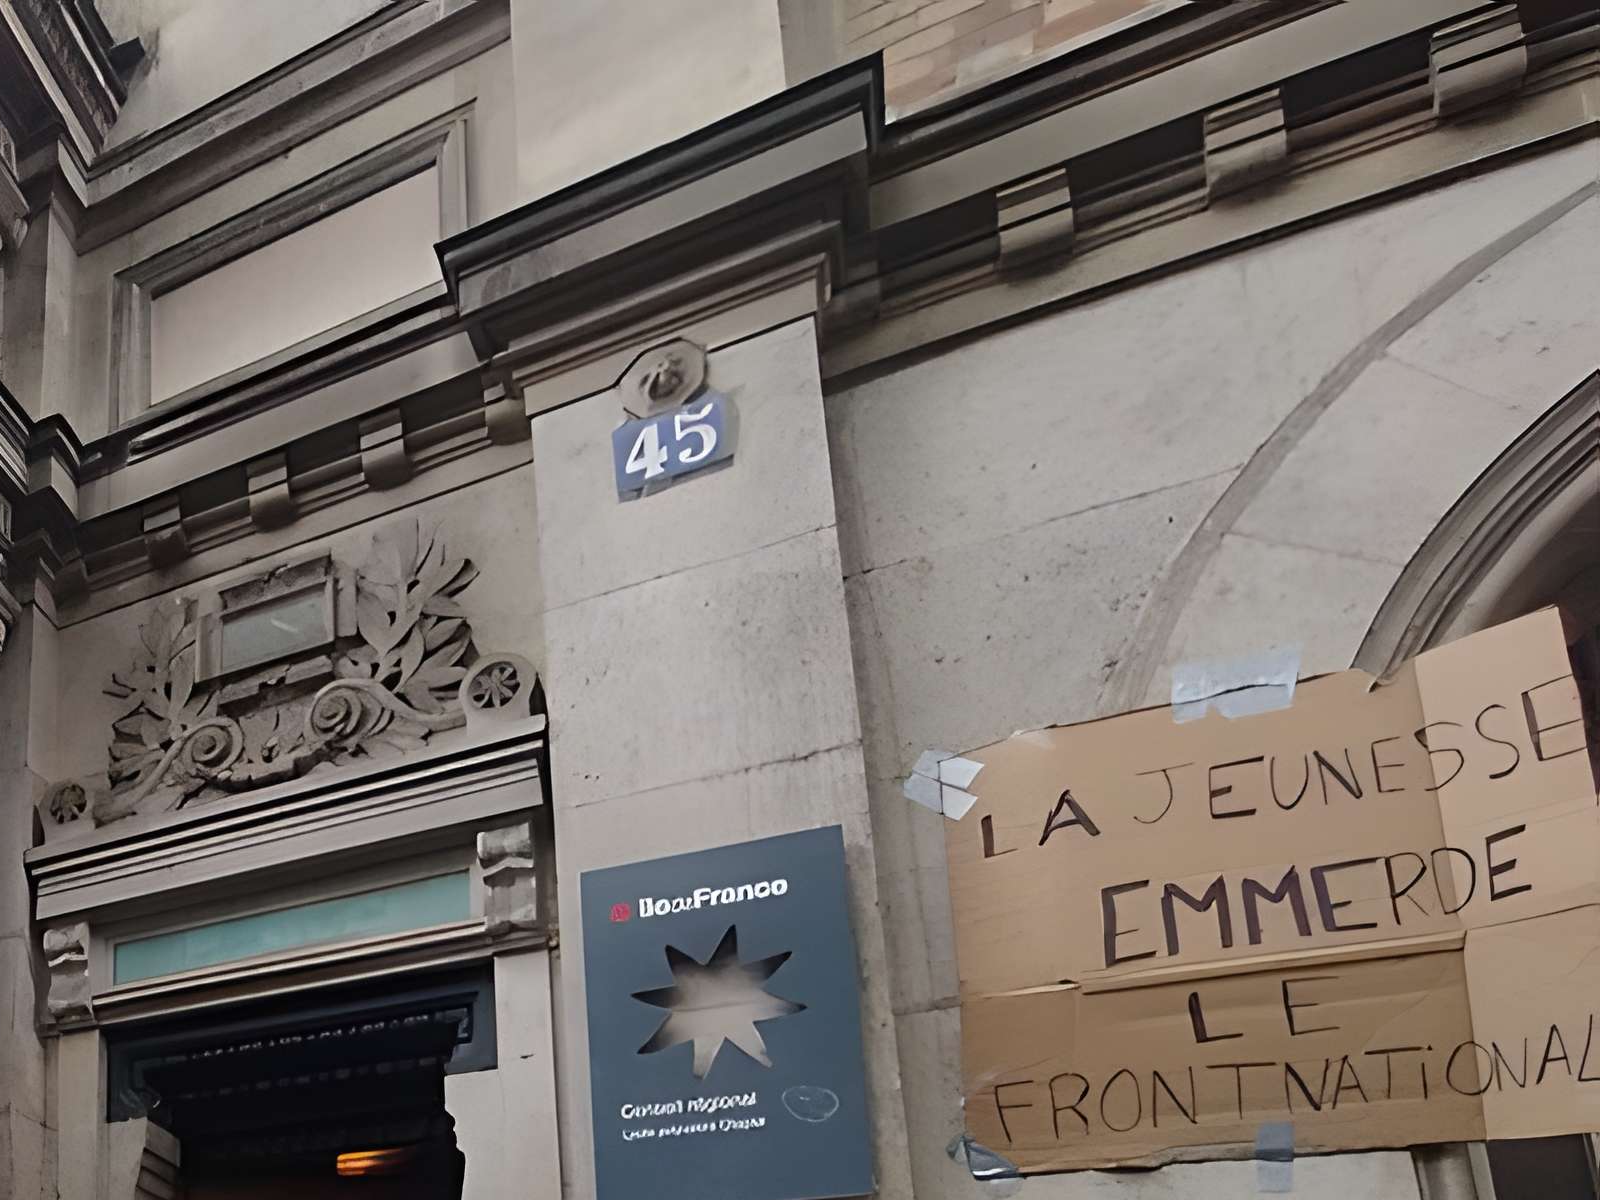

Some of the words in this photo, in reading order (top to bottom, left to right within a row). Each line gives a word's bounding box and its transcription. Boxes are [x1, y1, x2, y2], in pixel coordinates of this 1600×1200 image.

[625, 403, 717, 479] 45
[979, 789, 1101, 860] LA
[1134, 672, 1589, 825] JEUNESSE
[1101, 824, 1534, 968] EMMERDE
[1187, 976, 1341, 1044] LE
